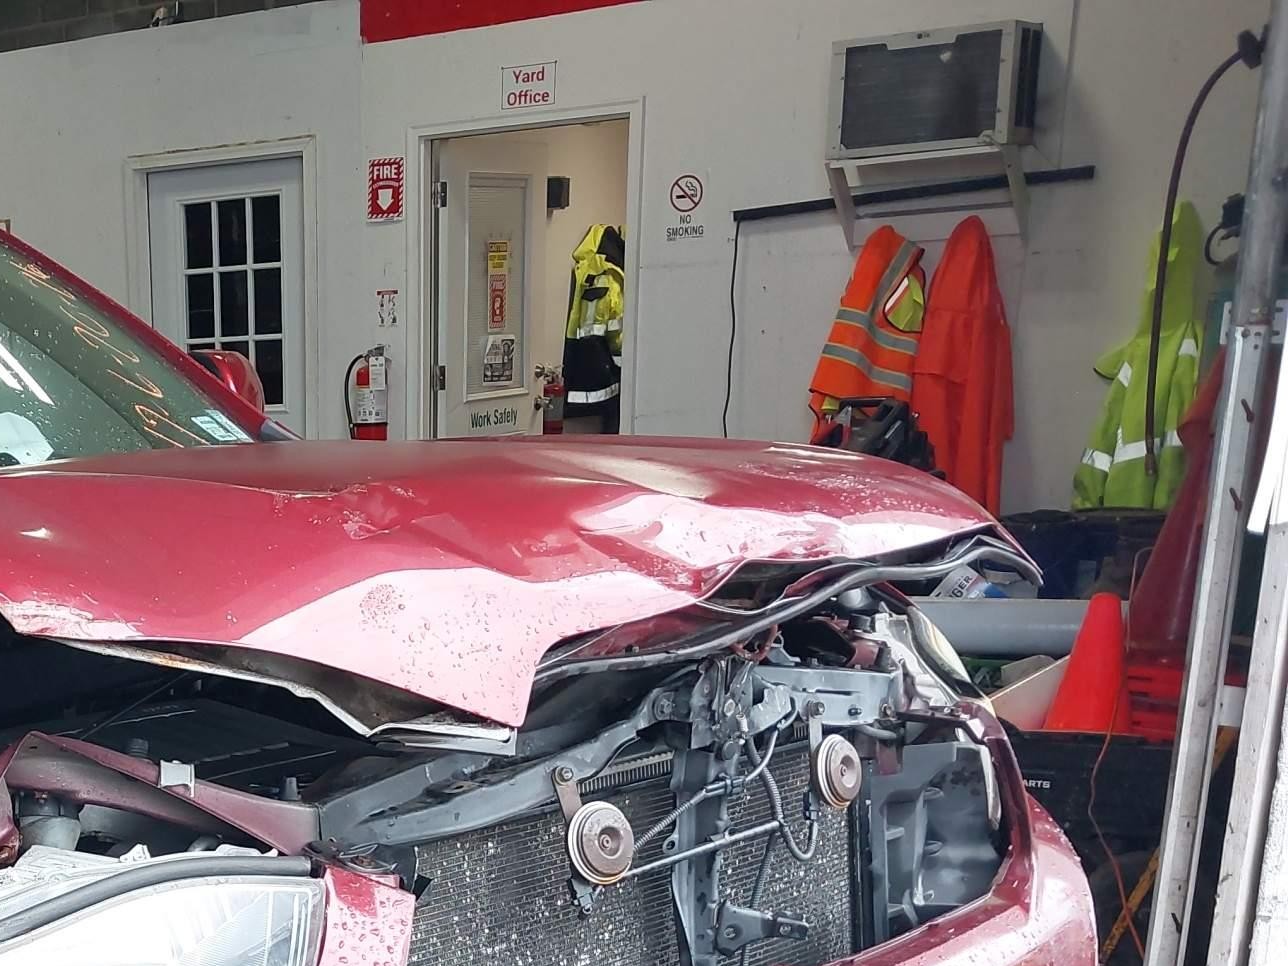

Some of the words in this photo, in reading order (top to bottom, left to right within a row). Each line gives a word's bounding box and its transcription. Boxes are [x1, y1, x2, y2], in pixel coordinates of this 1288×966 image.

[512, 65, 545, 84] Yard
[507, 89, 550, 106] Office
[373, 164, 399, 180] FIRE
[679, 214, 692, 225] NO
[666, 225, 704, 238] SMOKING
[470, 410, 492, 429] Work
[493, 407, 518, 426] Safely
[948, 575, 973, 598] GER
